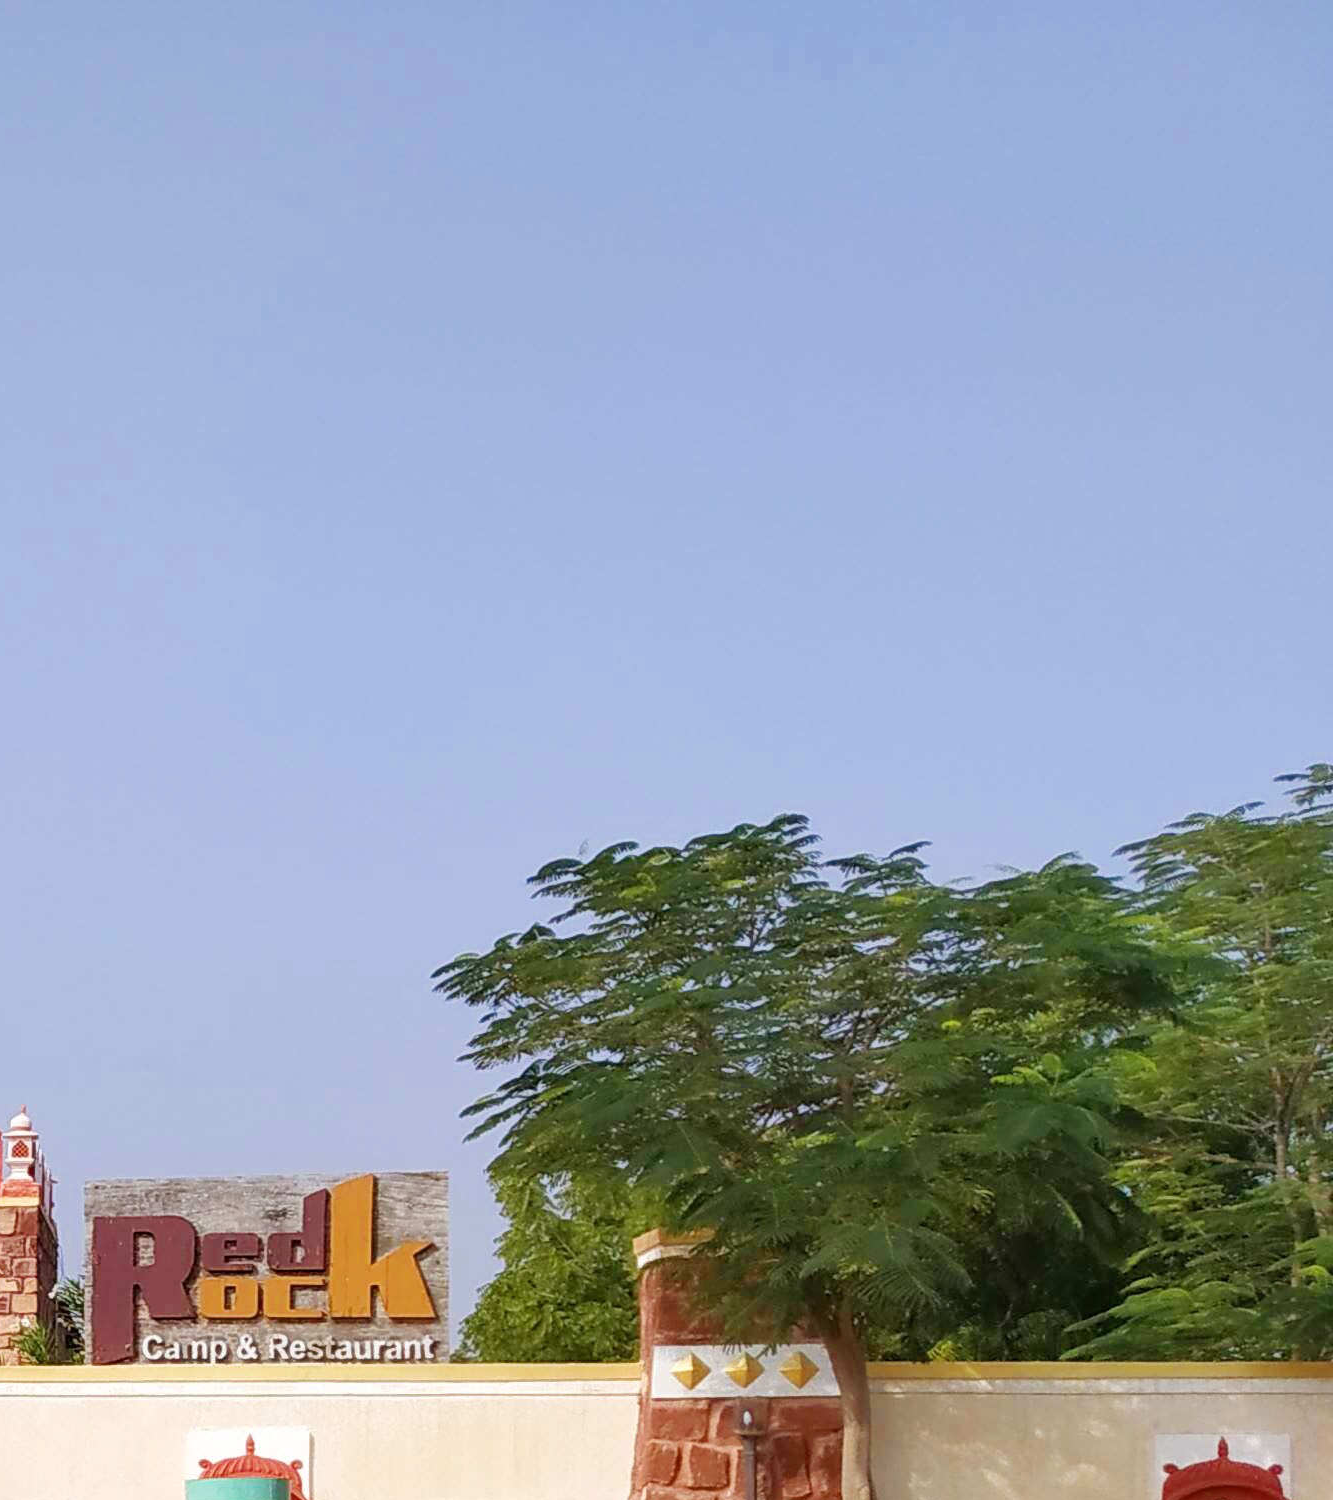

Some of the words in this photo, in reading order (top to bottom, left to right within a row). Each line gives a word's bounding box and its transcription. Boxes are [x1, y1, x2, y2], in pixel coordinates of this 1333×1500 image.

[92, 1188, 330, 1364] Red
[141, 1334, 227, 1364] Camp
[236, 1334, 259, 1360] &
[269, 1333, 434, 1361] Restaurant
